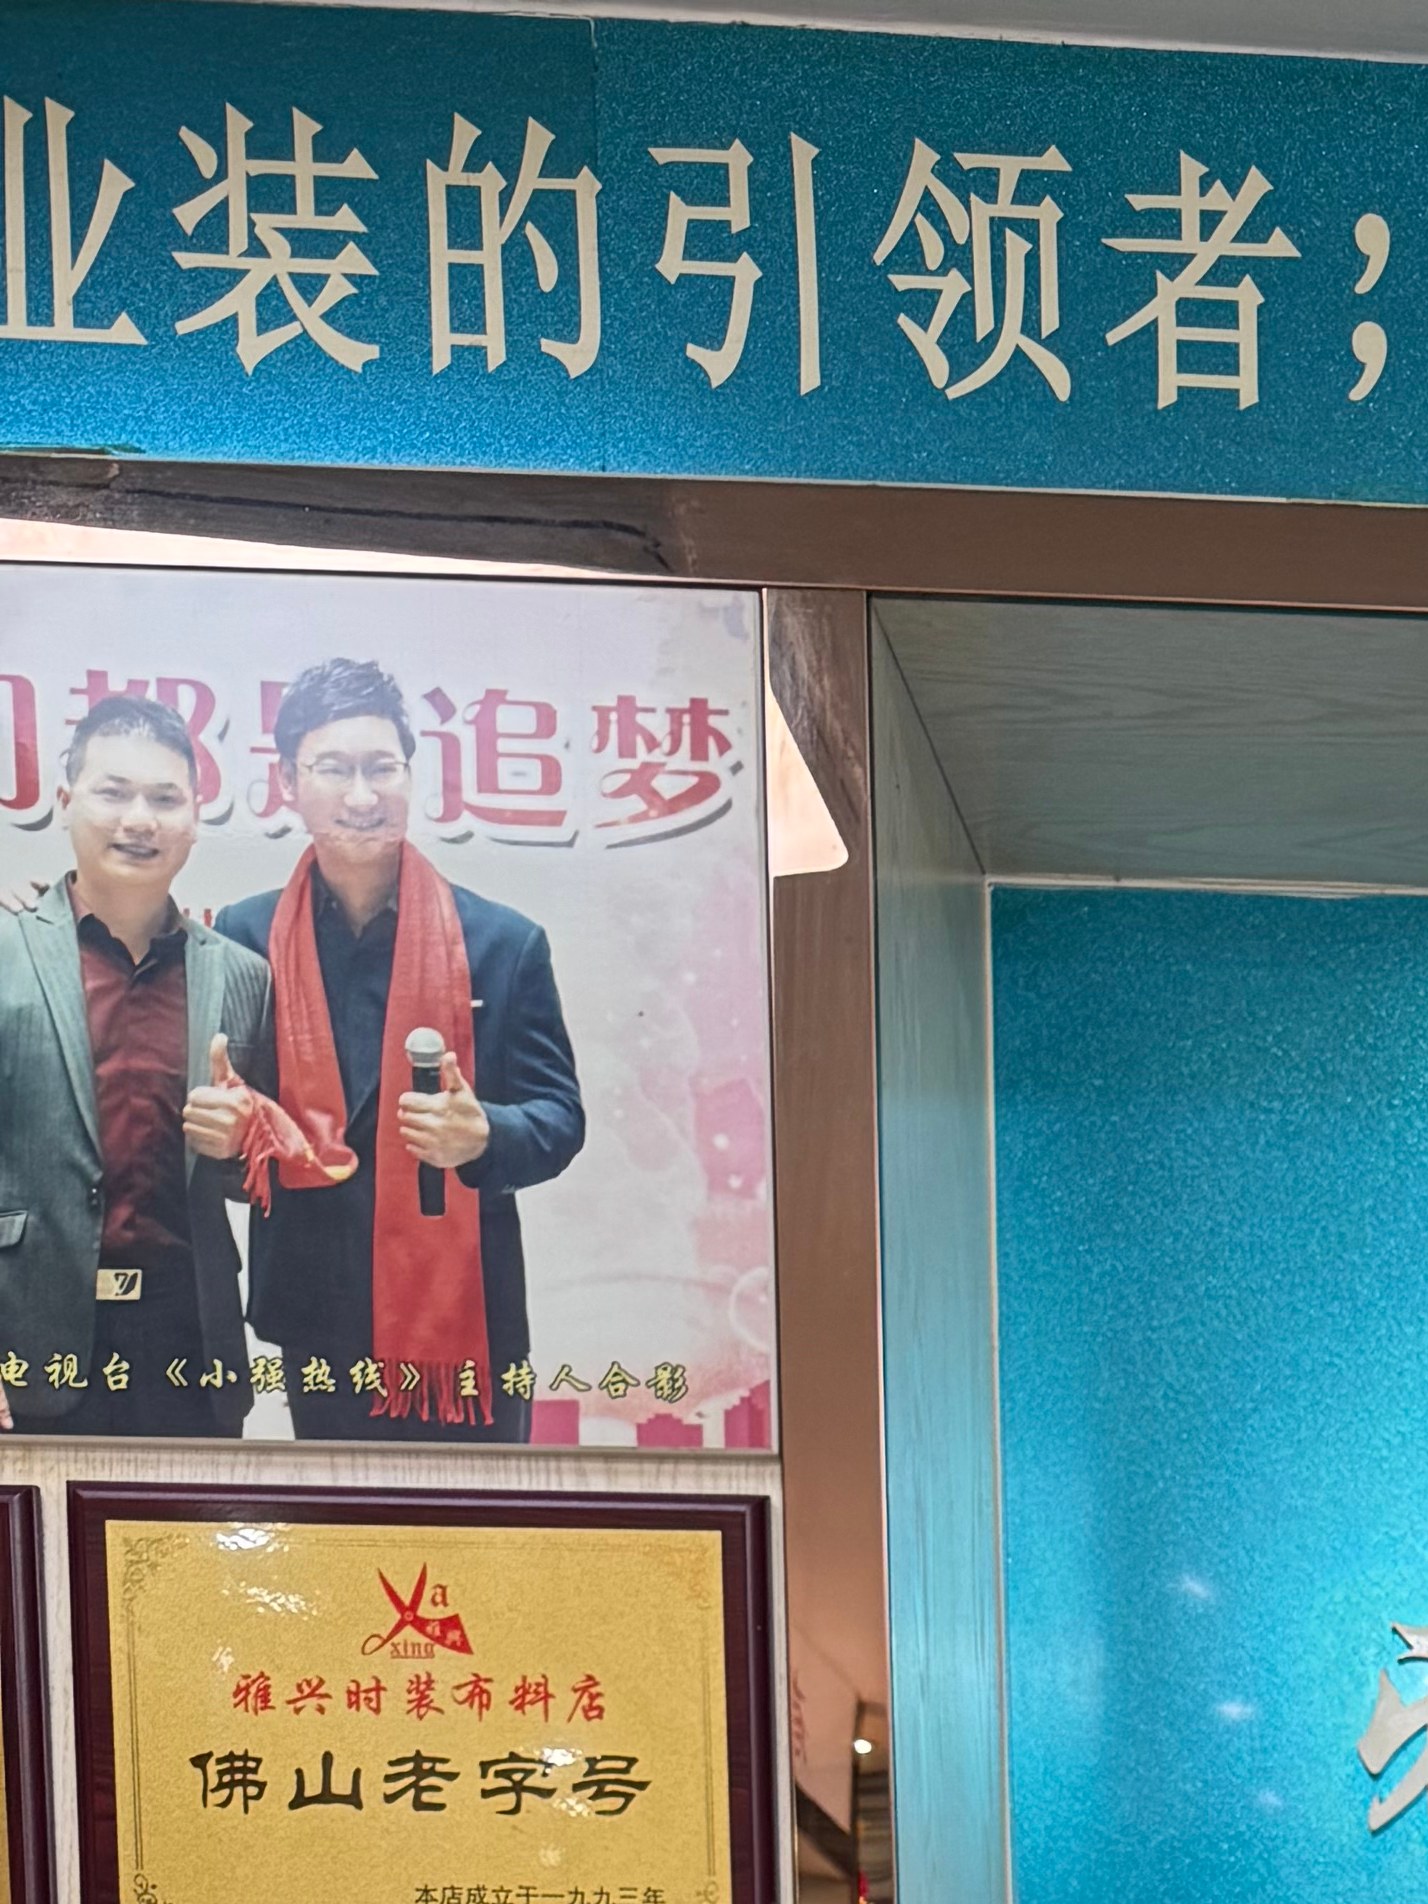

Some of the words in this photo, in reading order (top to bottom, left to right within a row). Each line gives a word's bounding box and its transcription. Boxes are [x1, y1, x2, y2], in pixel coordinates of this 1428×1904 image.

[231, 1670, 608, 1724] 雅兴时装布料店
[189, 1749, 652, 1816] 佛山老字号
